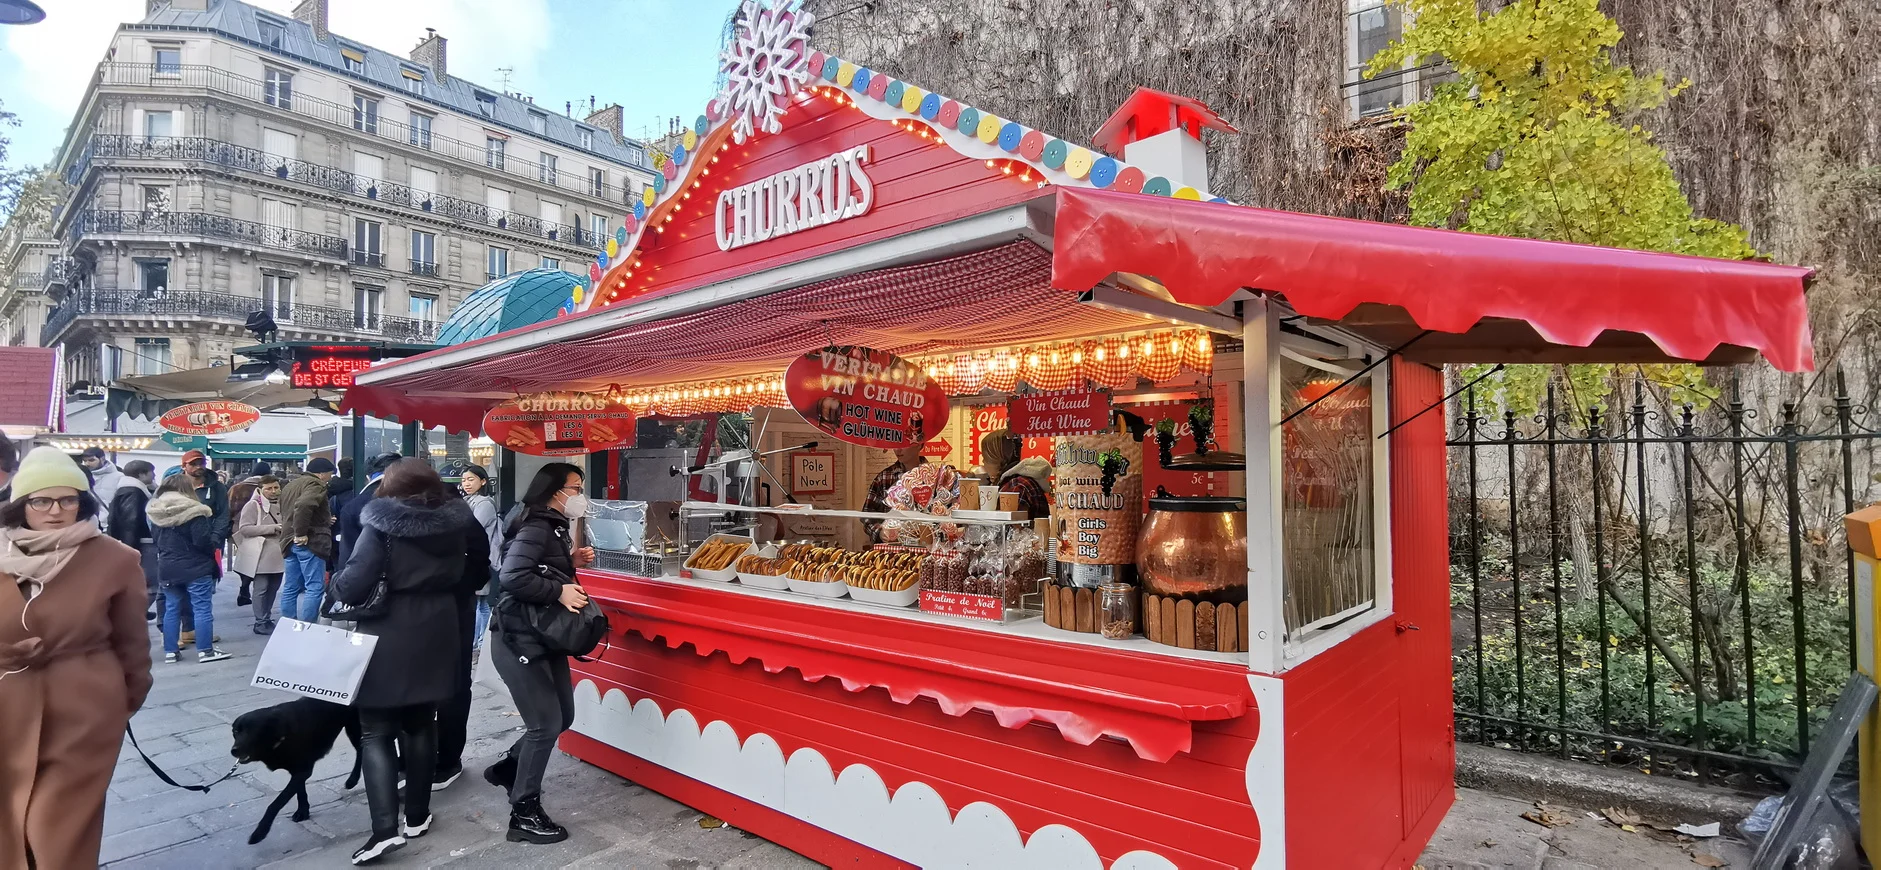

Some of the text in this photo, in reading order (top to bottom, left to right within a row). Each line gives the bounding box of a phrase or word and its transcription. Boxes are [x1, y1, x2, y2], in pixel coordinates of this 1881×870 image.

[715, 144, 873, 251] CHURROS
[820, 351, 927, 391] VERITABLE
[294, 374, 312, 386] DE
[315, 374, 329, 386] ST
[821, 374, 925, 409] VIN CHAUD
[519, 397, 606, 412] CHURROS
[1025, 394, 1091, 412] Vin Chaud
[555, 413, 587, 421] DEMANDE
[846, 403, 902, 425] HOT WINE
[563, 421, 583, 430] LES 6
[1027, 414, 1092, 431] Hot Wine
[561, 430, 583, 438] LES 12
[843, 421, 903, 443] GLÜHWEIN
[1028, 437, 1037, 449] 6
[802, 459, 824, 473] Pôle
[800, 475, 827, 487] Nord
[1191, 472, 1204, 484] 5€
[1068, 492, 1124, 510] CHAUD
[1078, 518, 1106, 530] Girls
[1078, 532, 1100, 544] Boy
[1078, 545, 1098, 558] Big
[925, 592, 996, 609] Praline de Noël
[962, 607, 978, 615] Grand
[256, 676, 349, 699] paco rabanne
